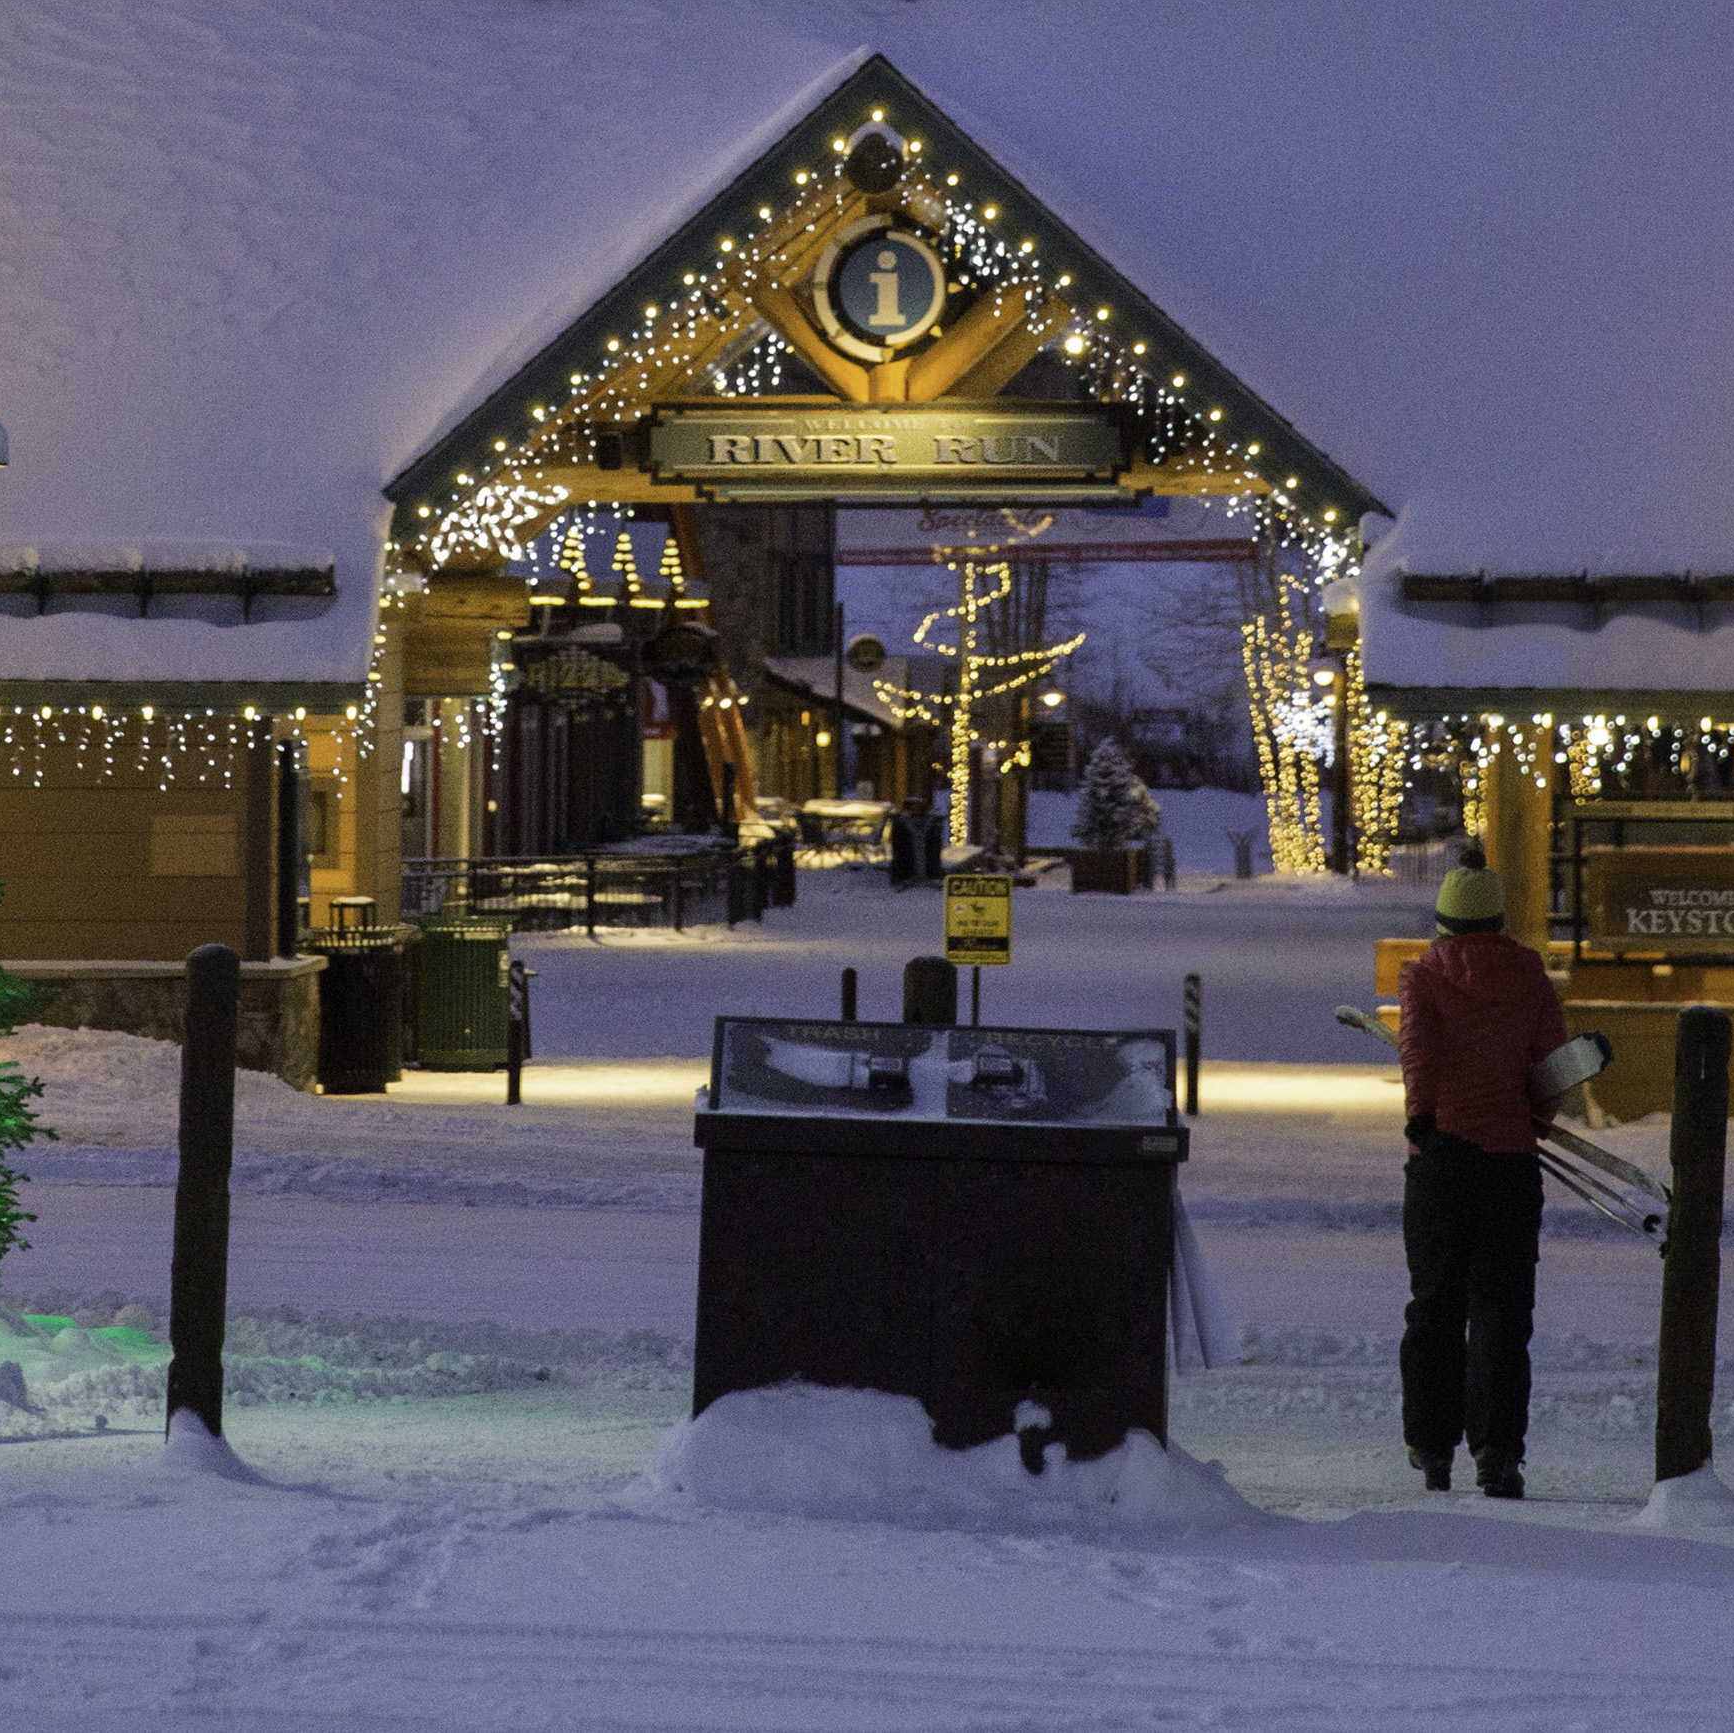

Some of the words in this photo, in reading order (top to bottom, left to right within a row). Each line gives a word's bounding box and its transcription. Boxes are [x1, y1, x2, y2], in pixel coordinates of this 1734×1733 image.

[804, 417, 924, 431] WELCOME
[706, 434, 897, 466] RIVER
[934, 434, 1063, 466] RUN
[951, 880, 1008, 895] CAUTION
[787, 1025, 881, 1042] TRASH
